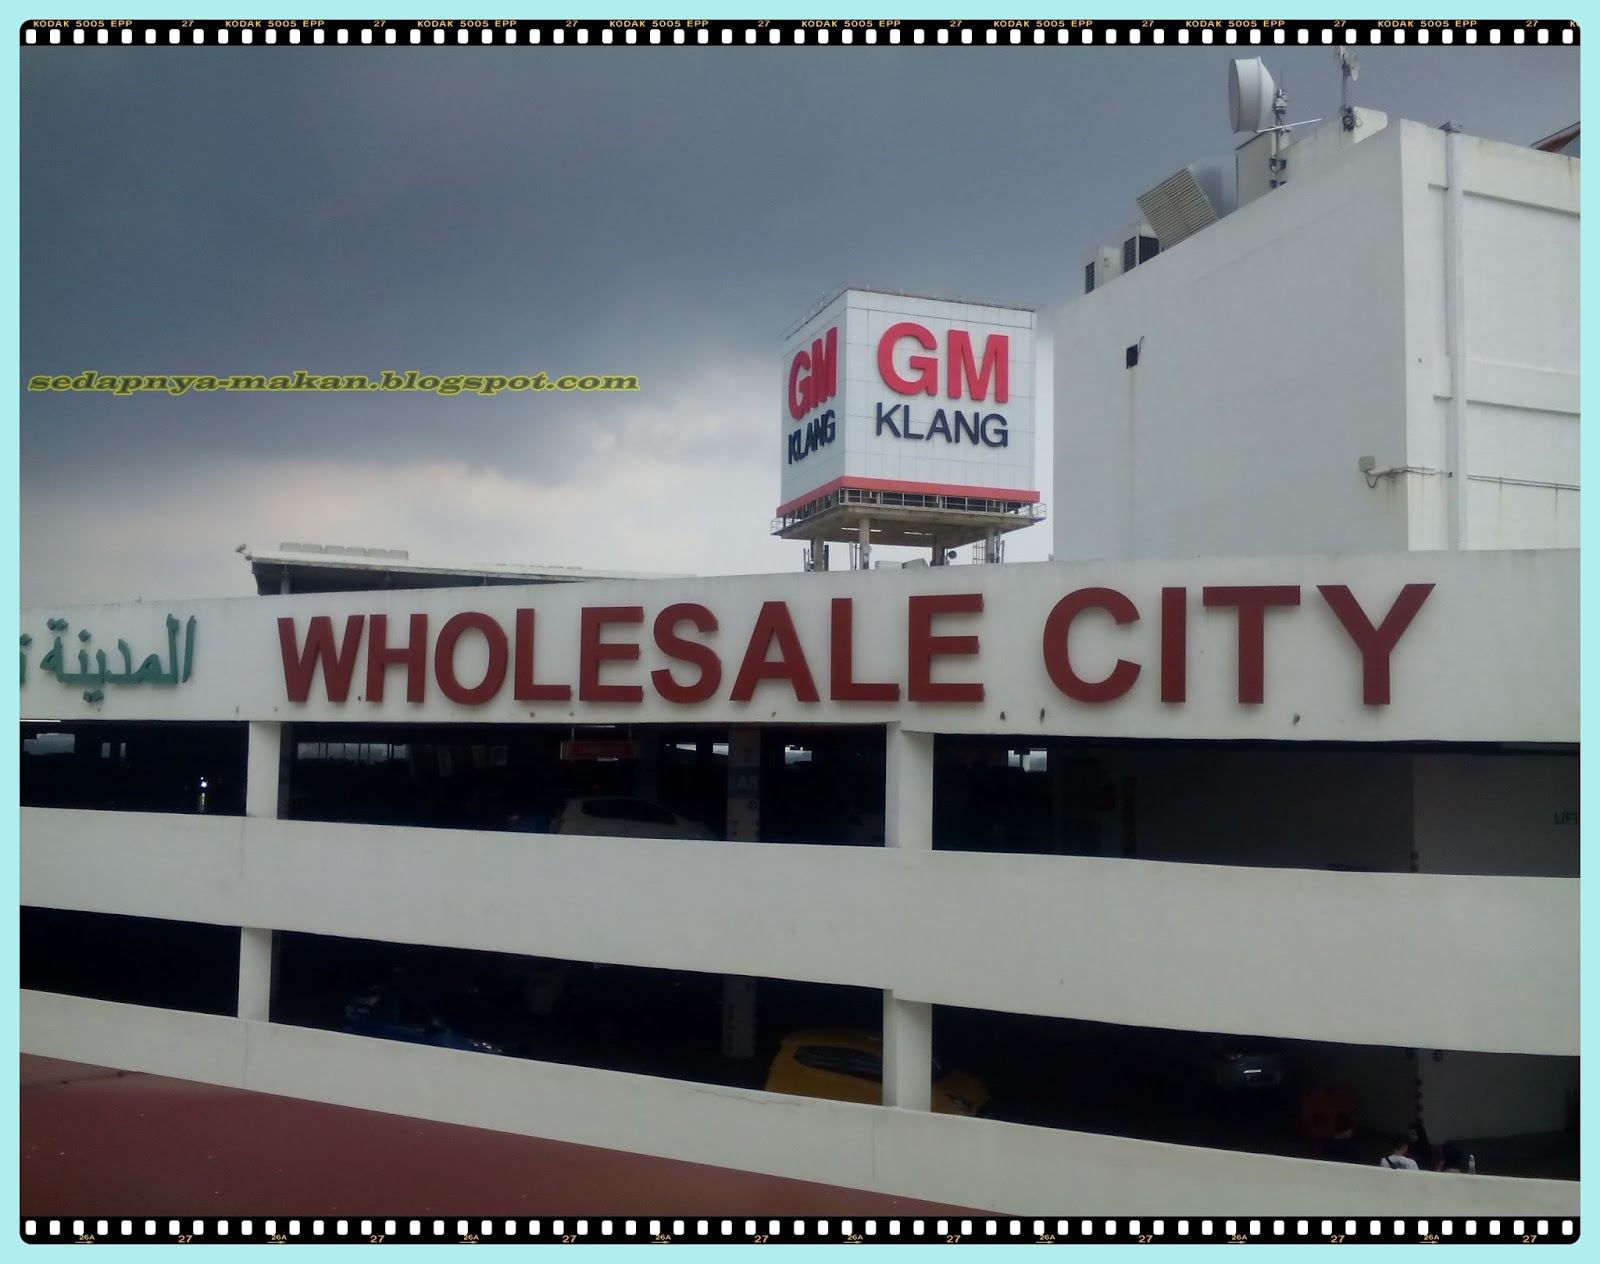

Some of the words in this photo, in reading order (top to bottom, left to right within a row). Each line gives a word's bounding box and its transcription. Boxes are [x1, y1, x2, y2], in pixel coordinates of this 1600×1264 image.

[788, 326, 838, 421] GM
[877, 322, 1009, 403] GM
[787, 409, 836, 465] KLANG
[876, 402, 1009, 448] KLANG
[40, 613, 197, 703] المدينة
[278, 594, 984, 707] WHOLESALE
[1042, 583, 1436, 705] CITY
